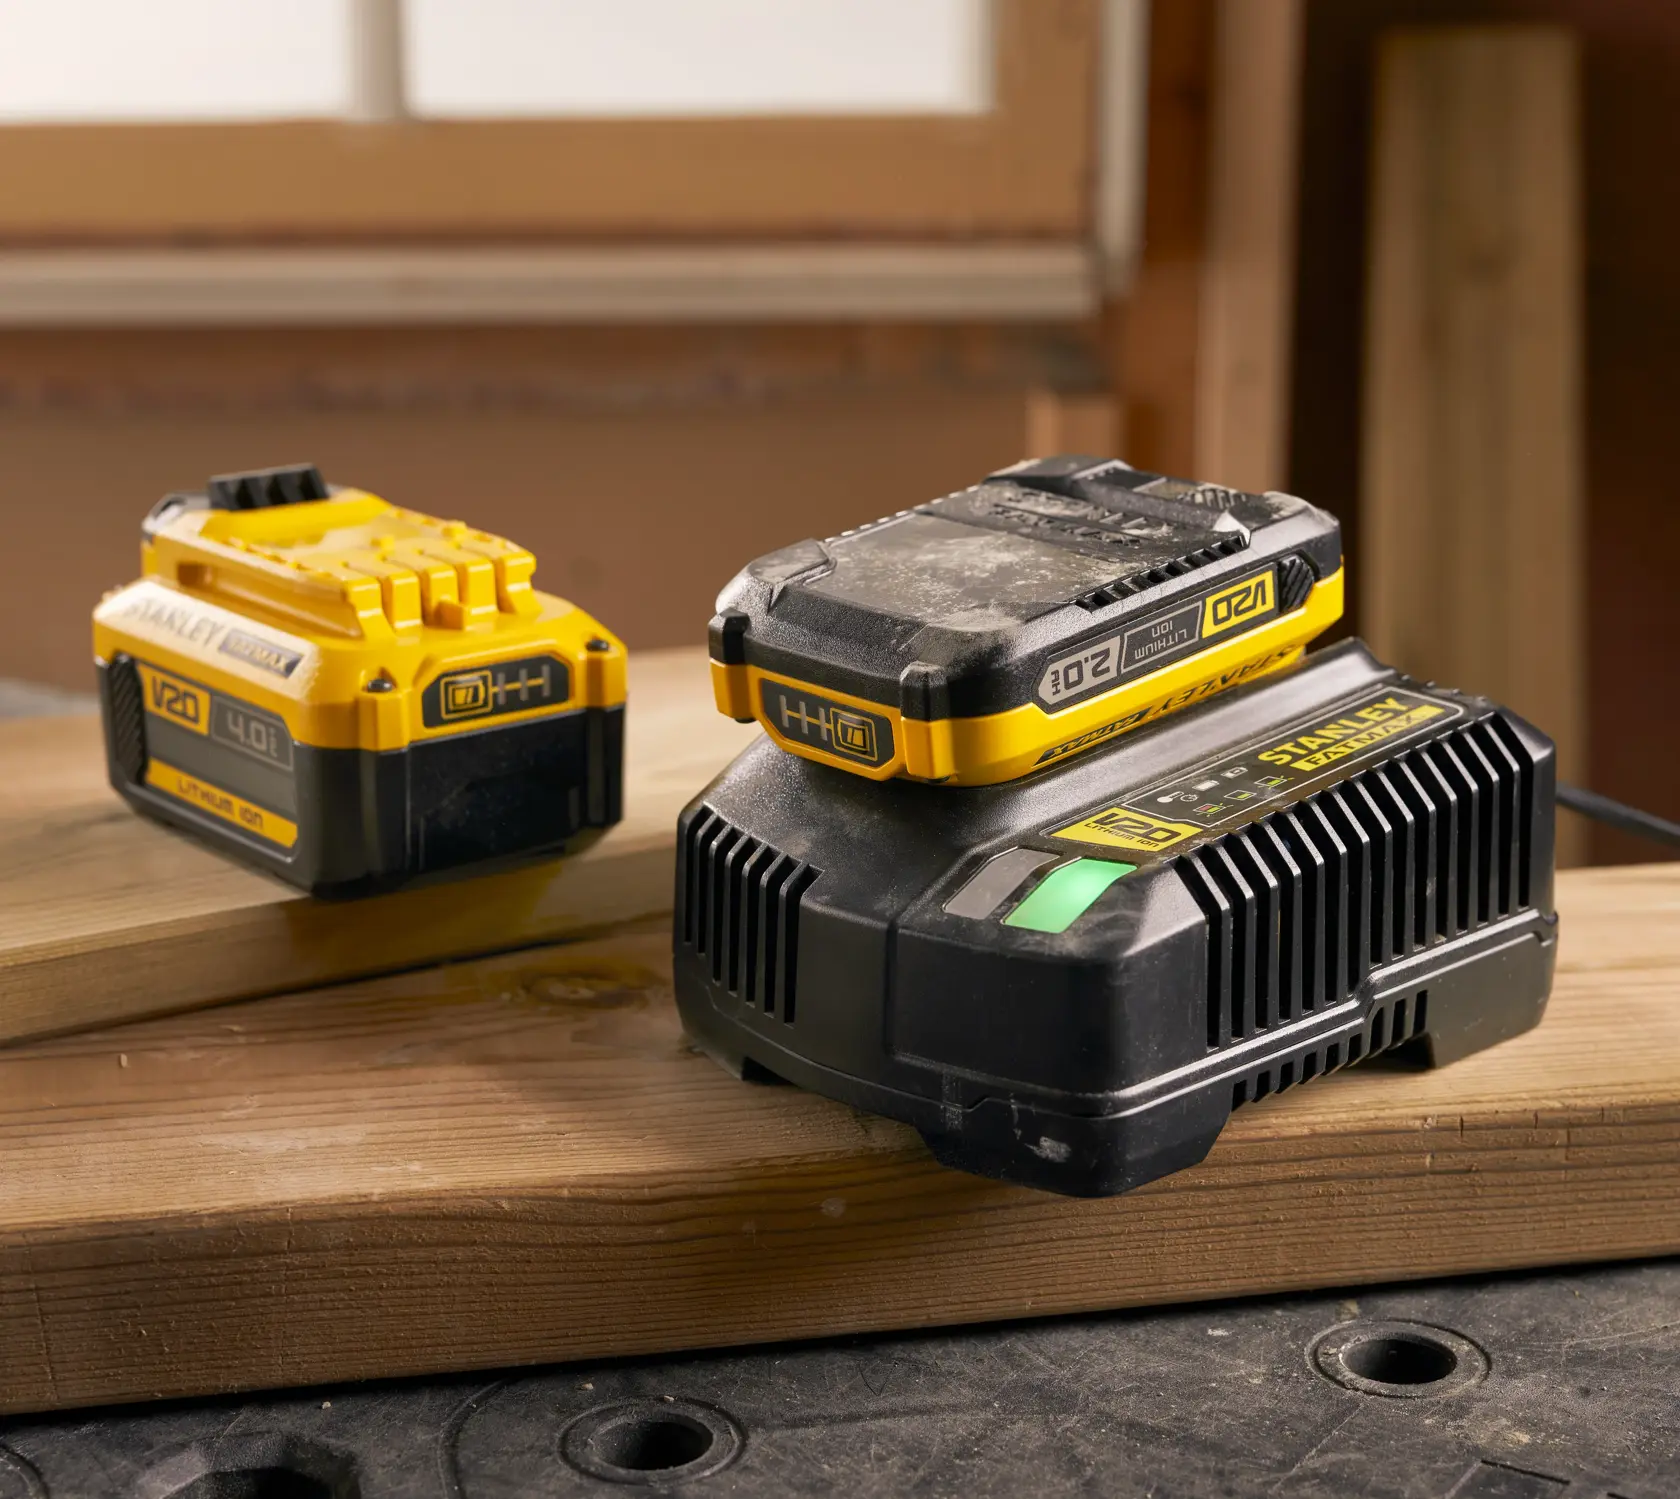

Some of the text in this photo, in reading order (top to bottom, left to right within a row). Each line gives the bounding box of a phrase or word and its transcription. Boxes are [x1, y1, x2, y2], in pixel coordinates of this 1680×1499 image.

[1212, 579, 1266, 626] V20
[1135, 628, 1187, 660] LITHIUM
[1152, 619, 1173, 638] ION
[1063, 646, 1111, 691] 2.0
[152, 675, 199, 725] V20
[227, 711, 267, 750] 4.0
[1257, 697, 1408, 766] STANLEY
[1303, 714, 1413, 766] FATMAX
[176, 776, 234, 816] LITHIUM
[1084, 822, 1135, 842] LITHIUM
[1093, 812, 1182, 843] V20
